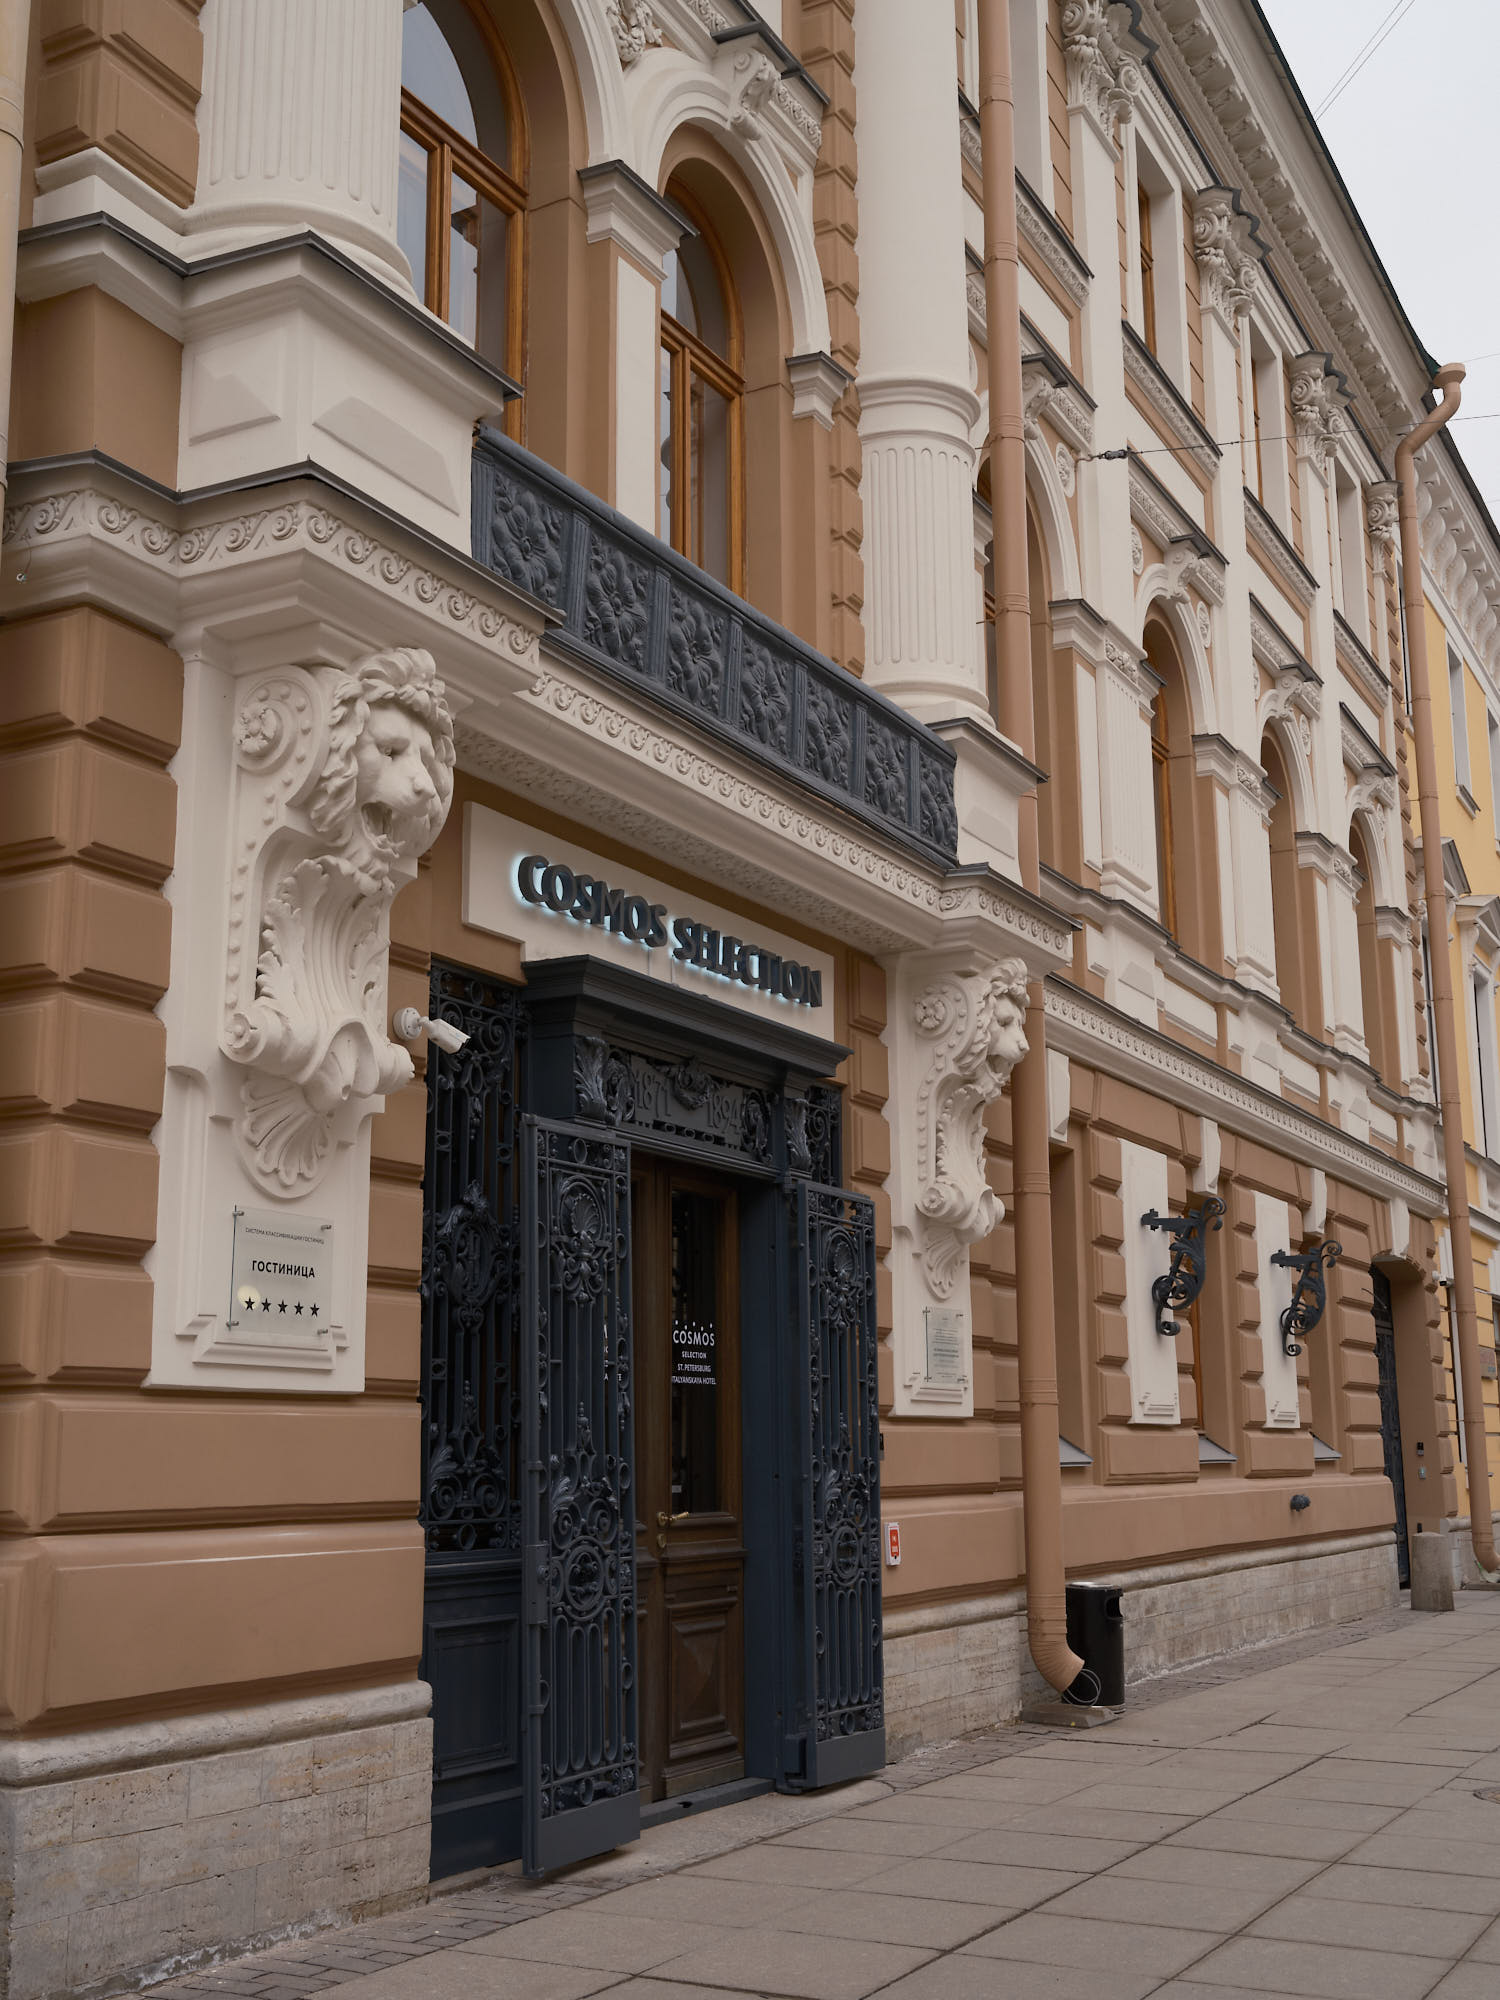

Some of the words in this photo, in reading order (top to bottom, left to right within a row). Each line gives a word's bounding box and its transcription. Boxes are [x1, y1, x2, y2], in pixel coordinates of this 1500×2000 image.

[518, 855, 668, 947] COSMOS
[673, 917, 823, 1007] SELECTION
[252, 1260, 315, 1278] ГОСТИНИЦА
[673, 1330, 715, 1346] COSMOS
[682, 1351, 707, 1359] SELECTION
